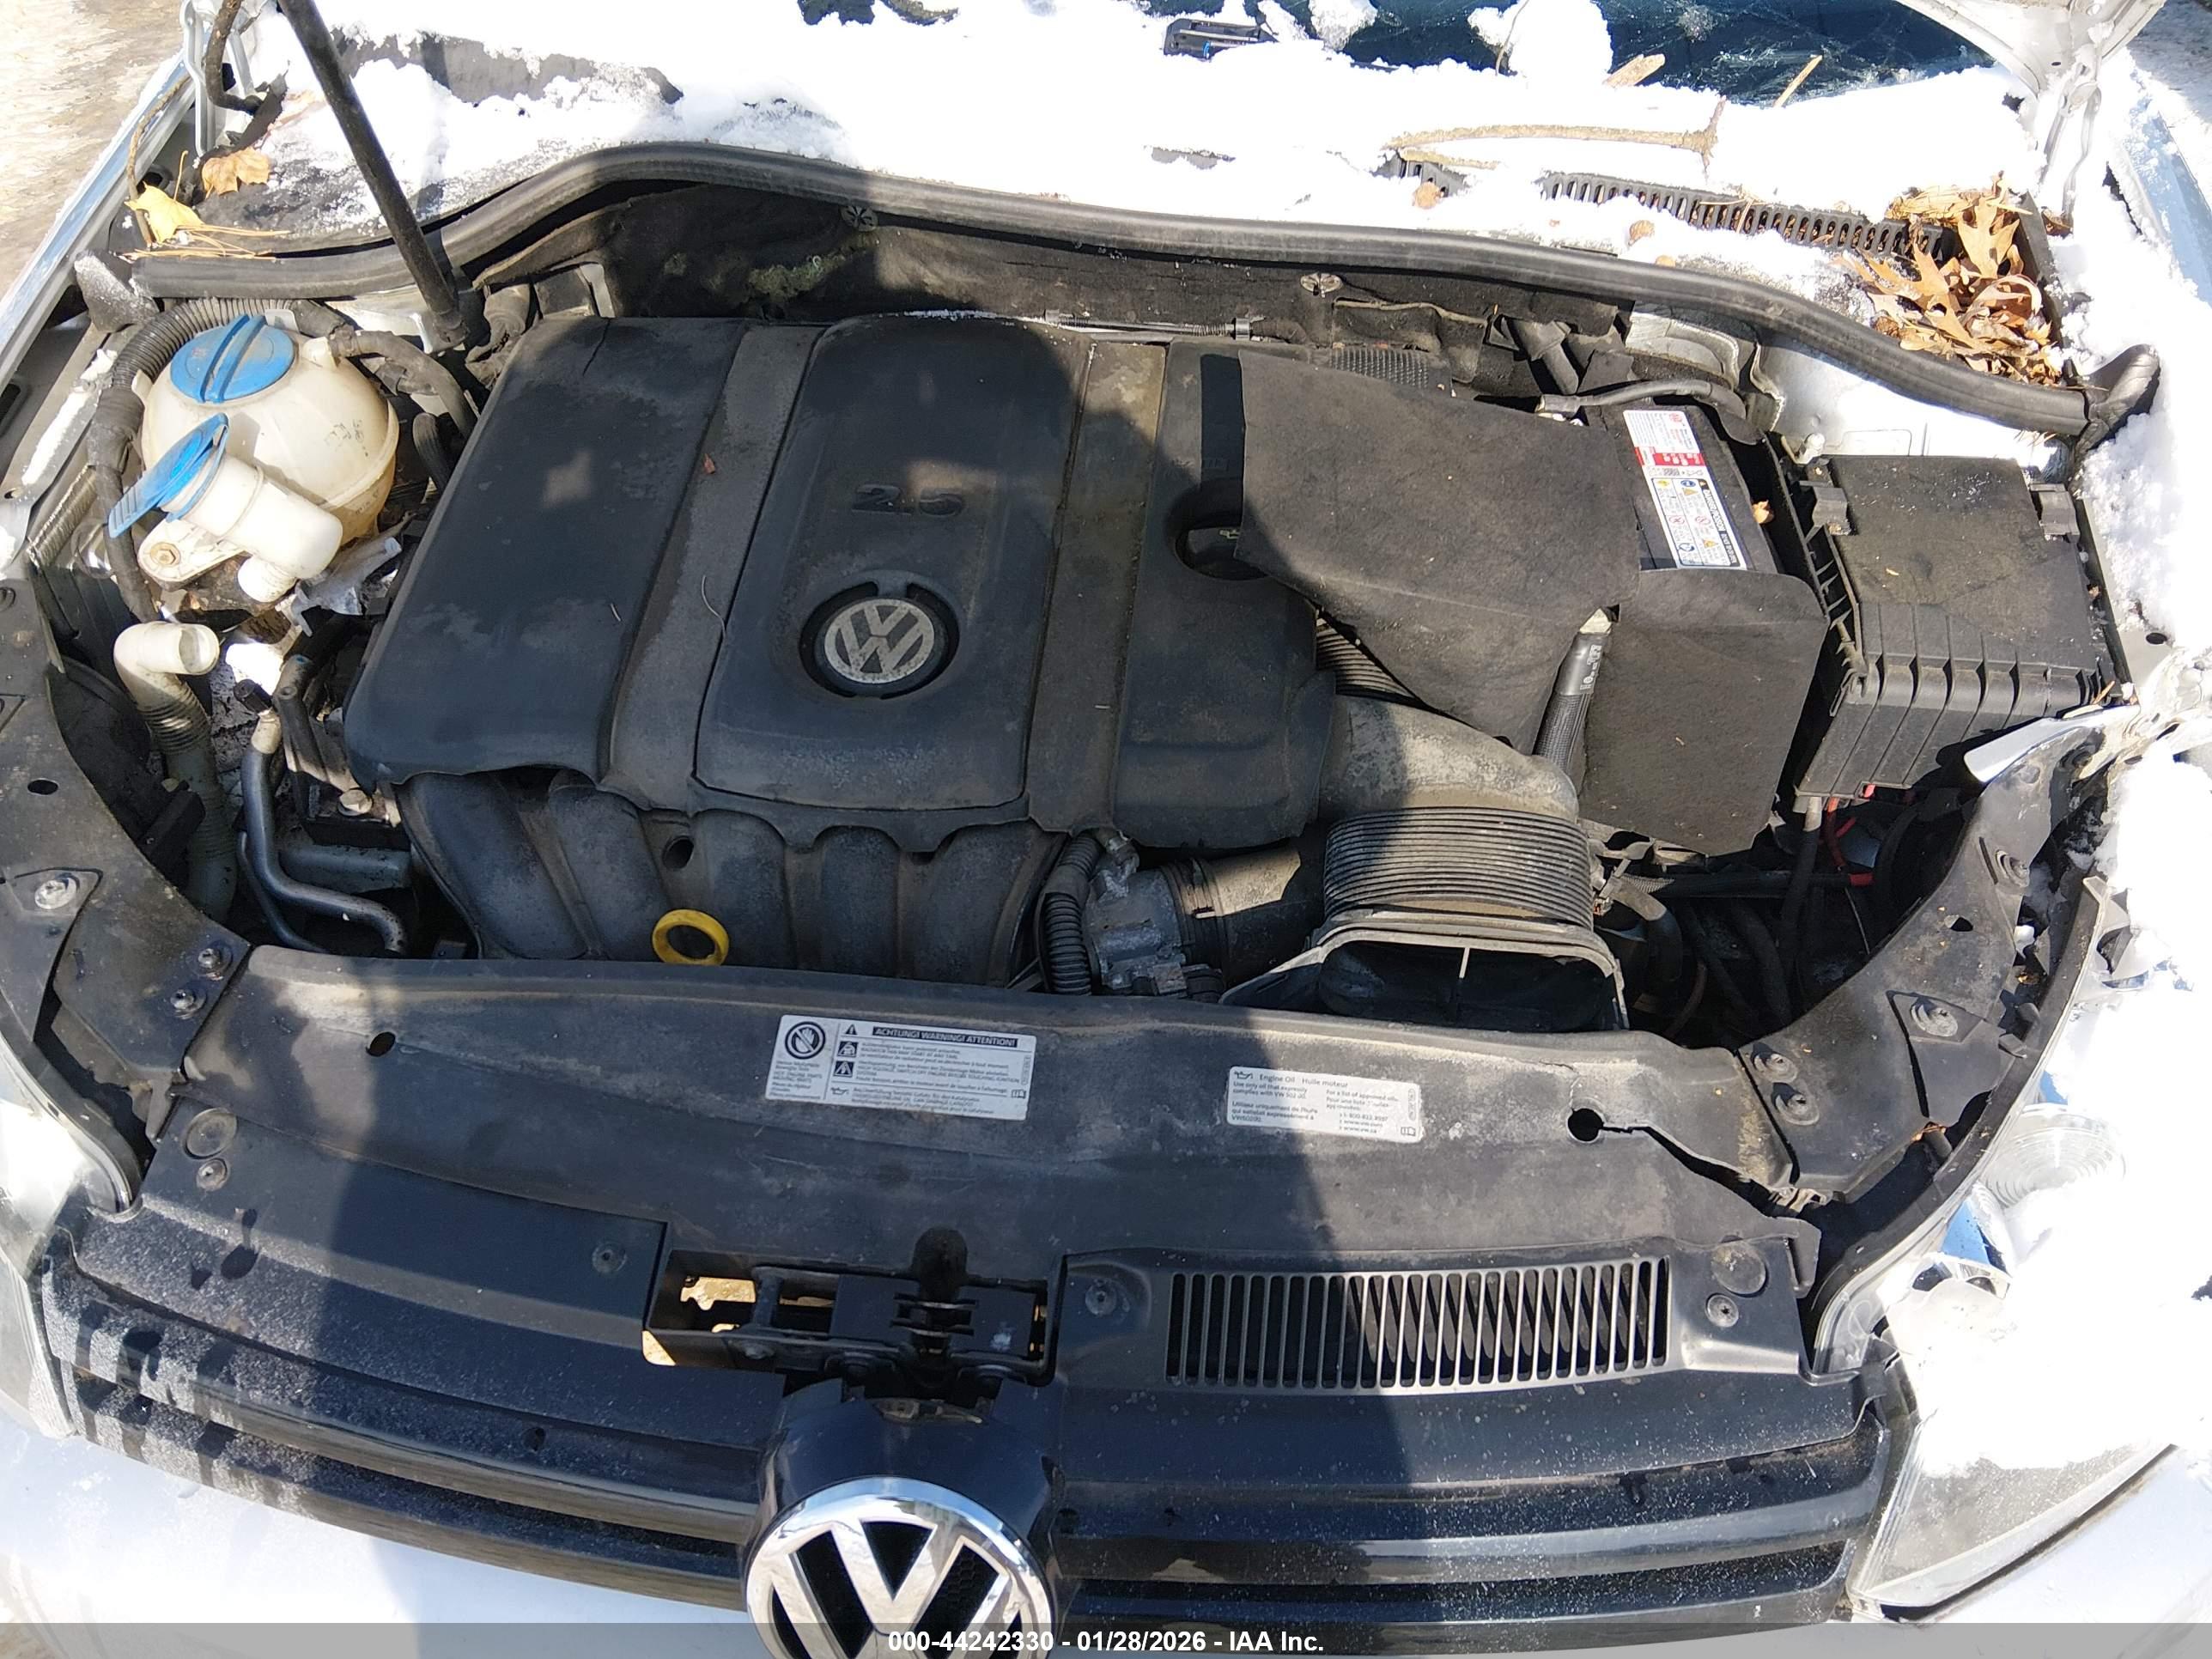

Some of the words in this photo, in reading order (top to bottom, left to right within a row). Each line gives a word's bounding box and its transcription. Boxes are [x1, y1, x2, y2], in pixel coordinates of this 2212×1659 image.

[875, 1028, 920, 1038] ACHTUNG!
[921, 1032, 965, 1042] WARNING!
[966, 1036, 1015, 1047] ATTENTION!
